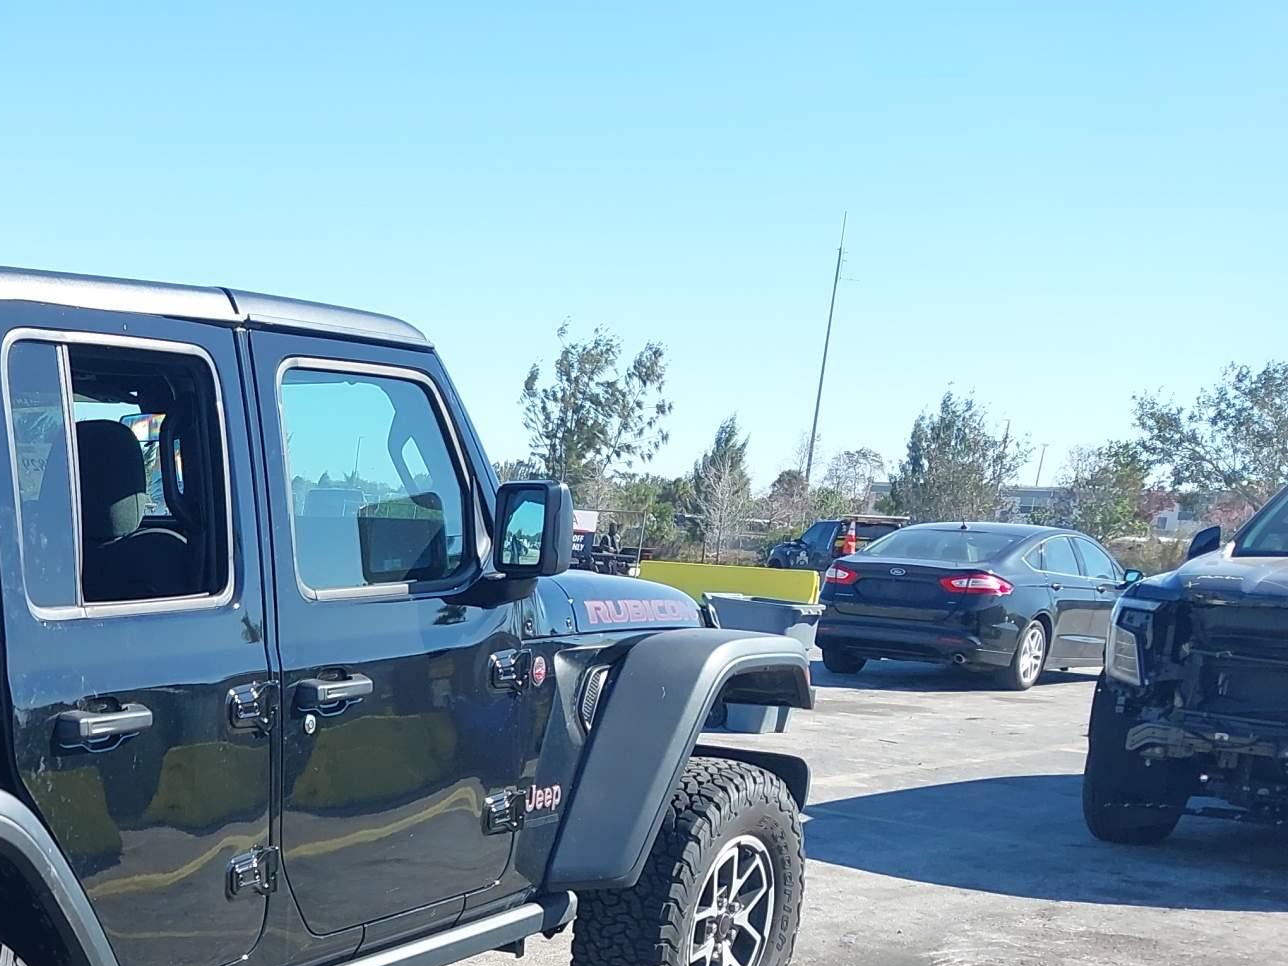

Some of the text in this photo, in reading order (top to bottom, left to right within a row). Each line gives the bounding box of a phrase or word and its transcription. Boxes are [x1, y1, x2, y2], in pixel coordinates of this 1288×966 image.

[572, 543, 585, 551] NLY
[584, 599, 698, 624] RUBICON
[525, 784, 561, 812] Jeep
